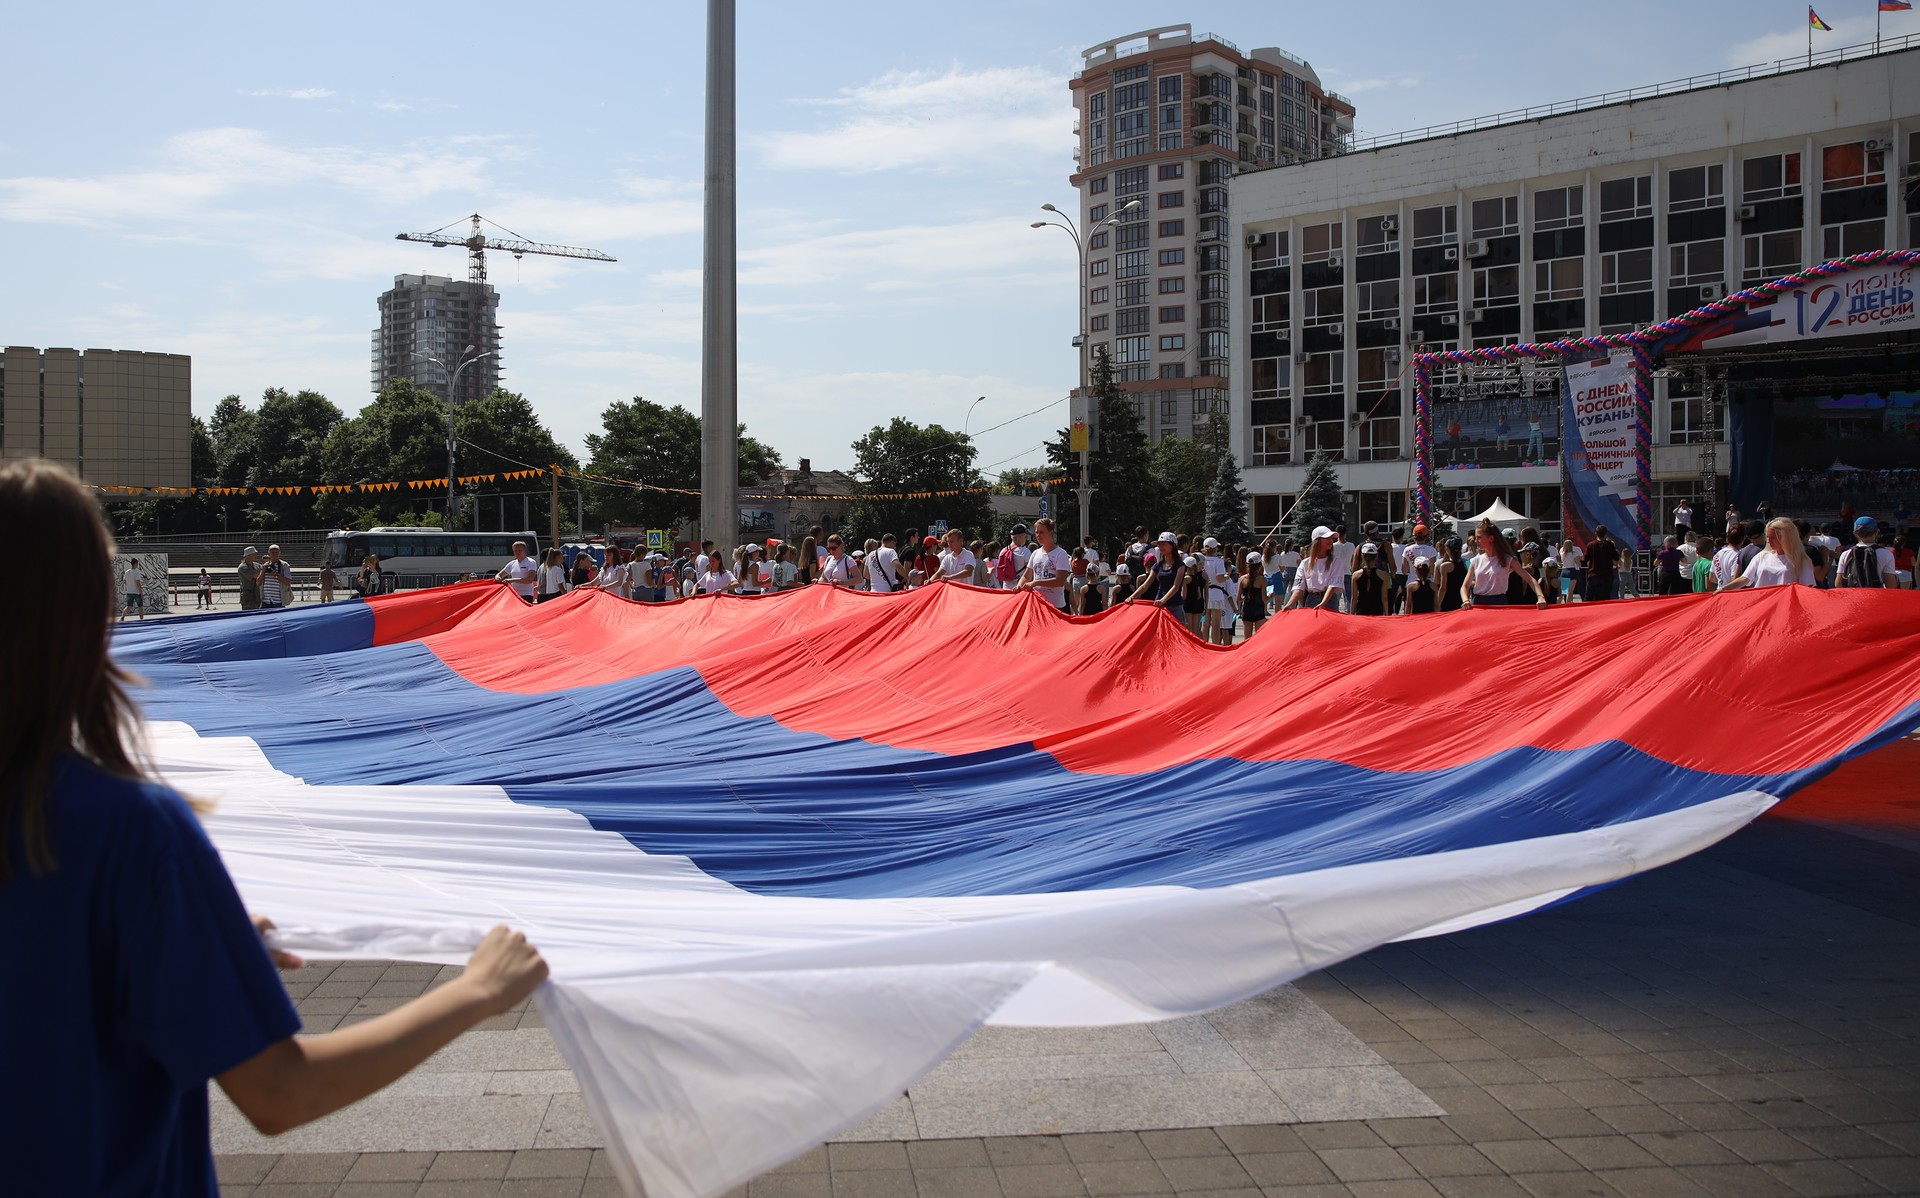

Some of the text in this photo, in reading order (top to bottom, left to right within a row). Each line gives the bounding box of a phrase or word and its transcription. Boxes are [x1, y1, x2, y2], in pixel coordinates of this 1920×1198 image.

[1793, 284, 1844, 336] 12
[1848, 286, 1914, 314] ДЕНЬ
[1848, 302, 1914, 326] РОССИИ
[1576, 382, 1628, 402] С ДНЕМ
[1577, 394, 1635, 416] РОССИИ,
[1577, 408, 1635, 428] КУБАНЬ!
[1580, 436, 1627, 449] БОЛЬШОЙ
[1584, 461, 1625, 471] КОНЦЕРТ
